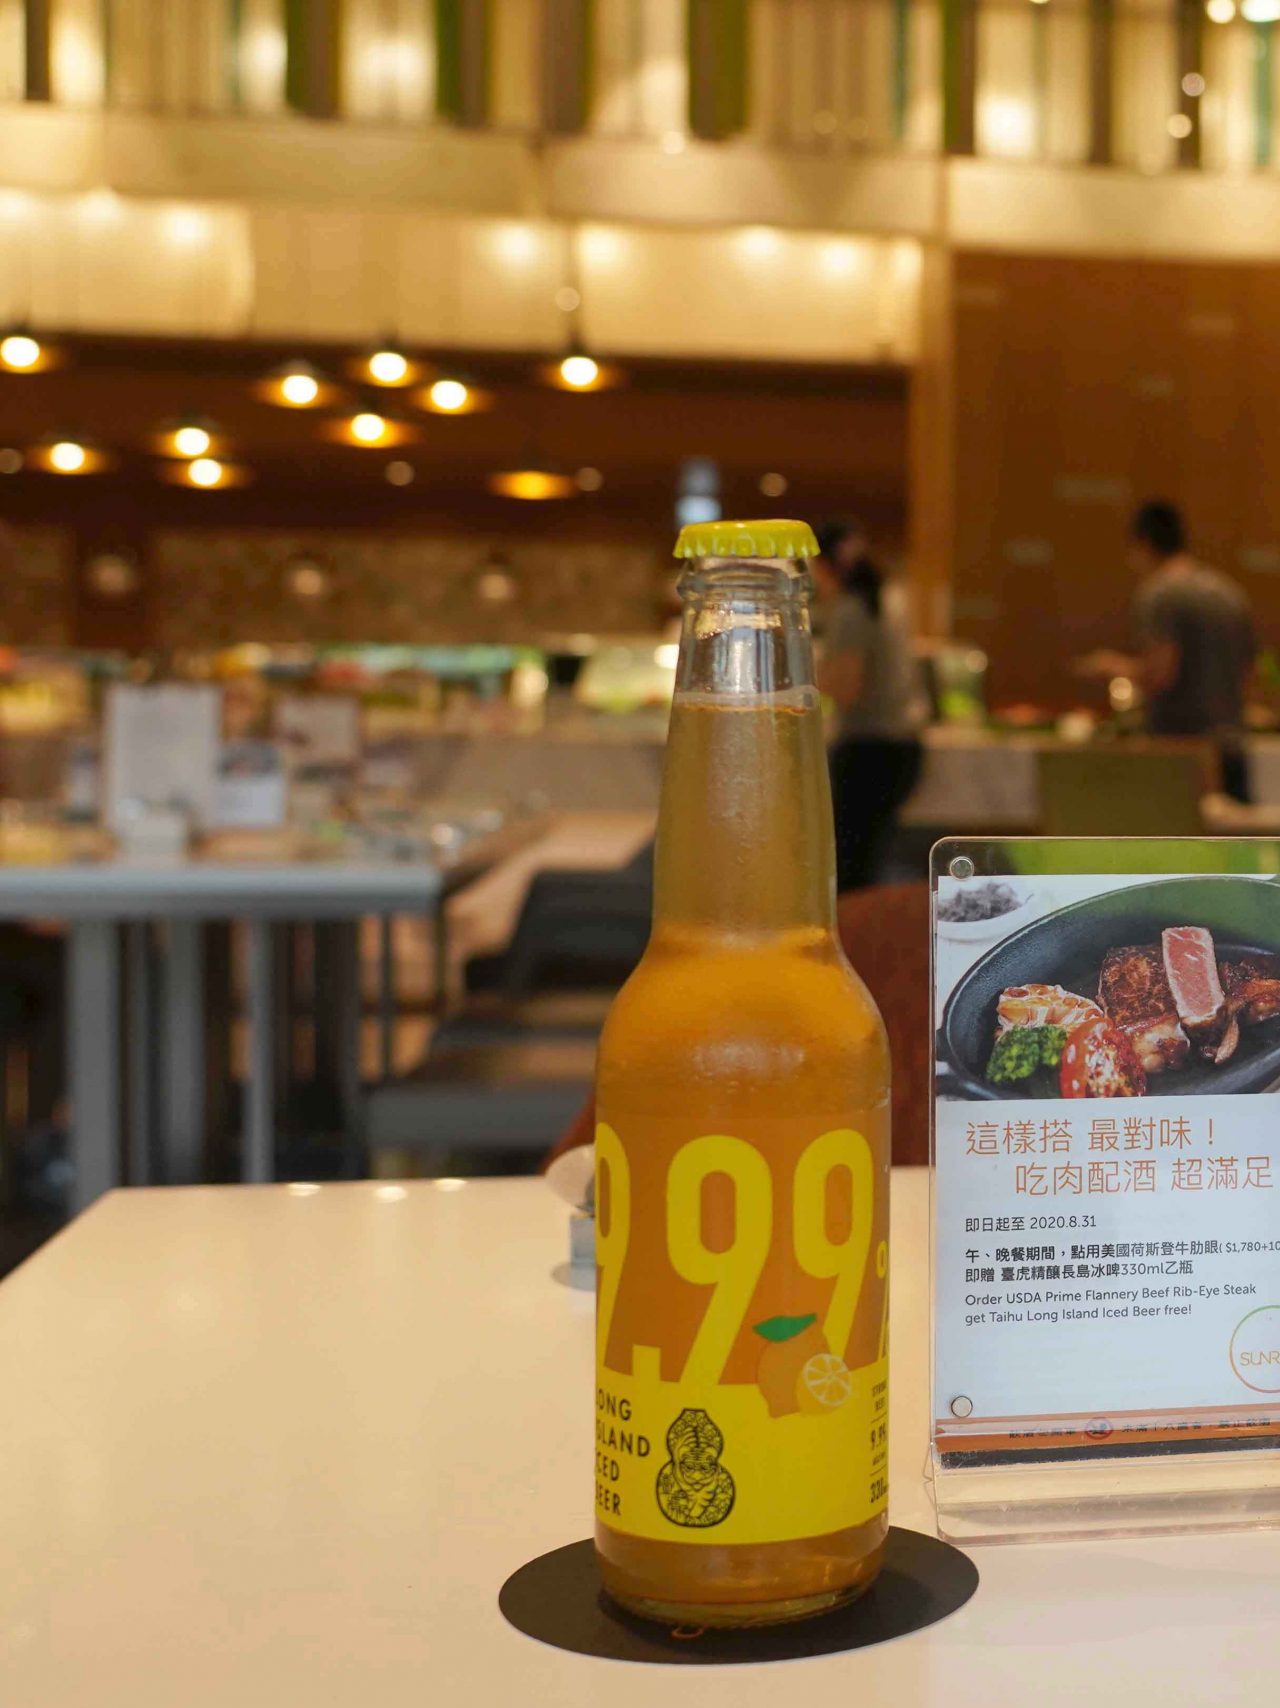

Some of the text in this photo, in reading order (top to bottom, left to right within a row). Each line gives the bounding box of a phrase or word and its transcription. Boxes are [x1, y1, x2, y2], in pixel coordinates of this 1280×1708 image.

[1029, 1214, 1097, 1229] 2020.8.31
[964, 1282, 1257, 1306] Order USDA Prime Flannery Beef Rib-Eye Steak
[964, 1303, 1192, 1327] get Taihu Long Island Iced Beer free!
[596, 1388, 632, 1421] ONG
